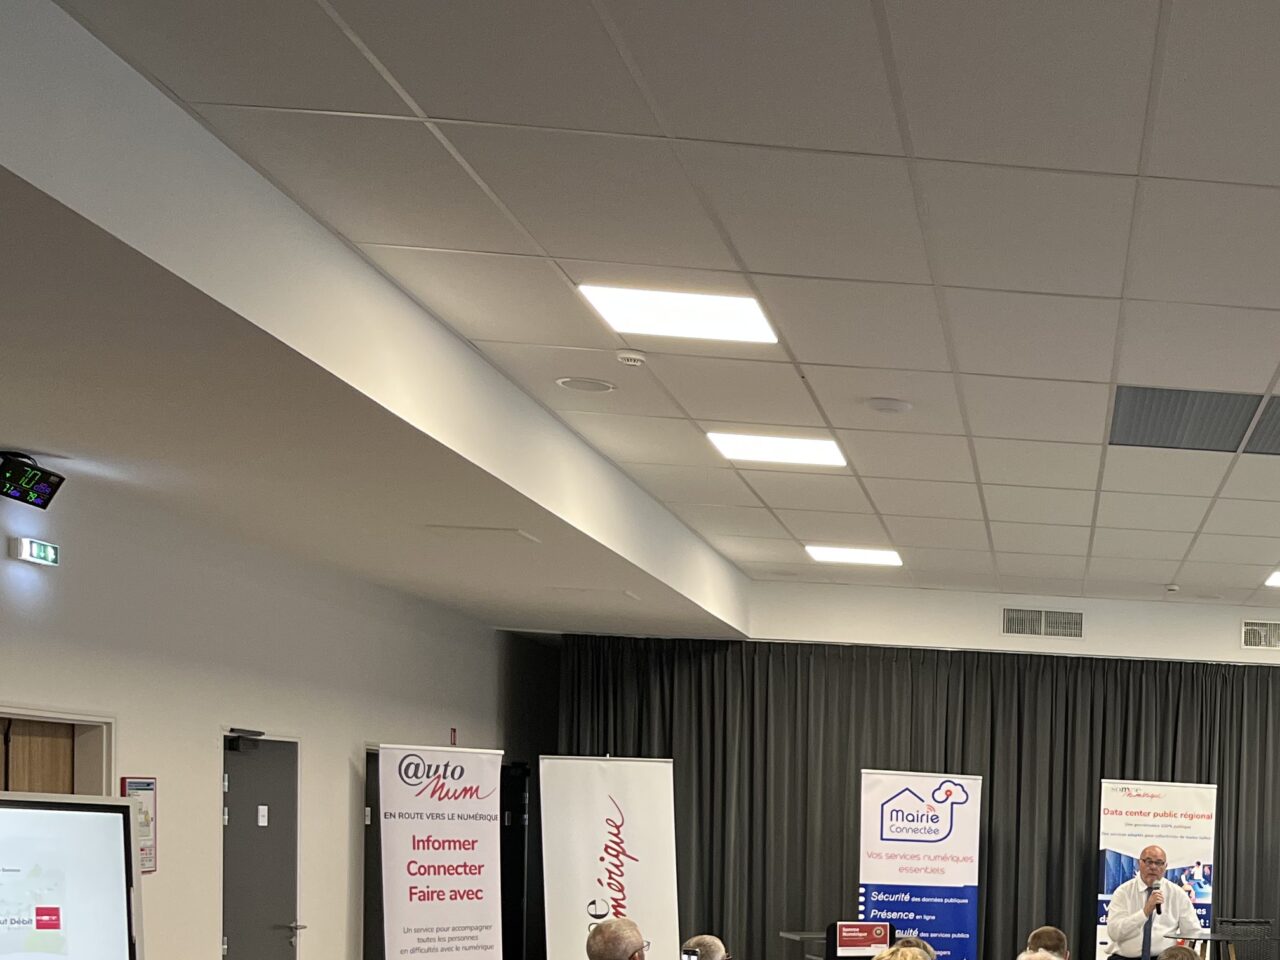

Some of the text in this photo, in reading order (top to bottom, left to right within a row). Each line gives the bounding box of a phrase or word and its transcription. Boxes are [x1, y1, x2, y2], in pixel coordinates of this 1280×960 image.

[398, 812, 424, 820] ROUTE
[425, 812, 445, 820] VERS
[457, 812, 499, 822] NUMÉRIQUE
[1103, 808, 1213, 820] Data center public régional
[890, 824, 939, 835] Connectée
[412, 834, 478, 850] Informer
[598, 795, 639, 918] mérique
[867, 851, 974, 864] Vos services numériques
[406, 860, 485, 876] Connecter
[898, 866, 945, 875] essentiels
[409, 885, 483, 901] Faire avec
[871, 891, 910, 902] Sécurité
[921, 896, 944, 904] données
[870, 909, 915, 920] Présence
[923, 913, 936, 921] ligne
[403, 924, 493, 936] Un service pour accompagner
[417, 935, 479, 944] toutes les personnes
[409, 945, 439, 954] difficultés
[461, 943, 495, 952] numérique
